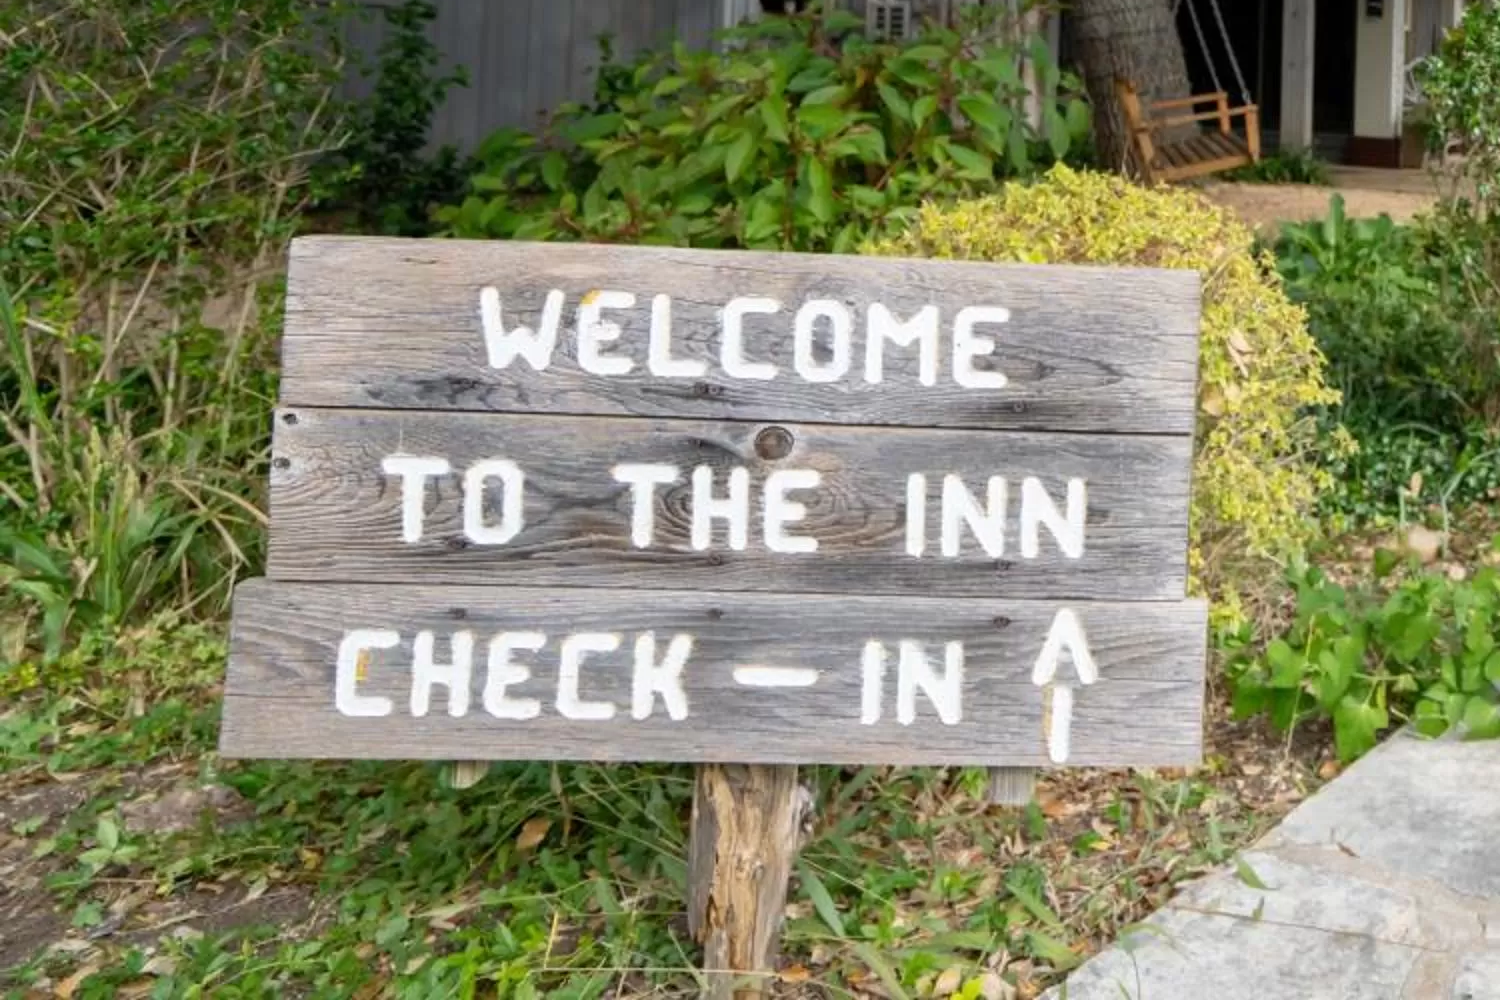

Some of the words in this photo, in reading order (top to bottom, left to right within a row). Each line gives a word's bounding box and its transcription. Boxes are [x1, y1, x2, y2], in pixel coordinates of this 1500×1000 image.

[479, 287, 1010, 390] WELCOME
[381, 456, 524, 545] TO
[613, 464, 821, 554] THE
[905, 472, 1086, 560] INN
